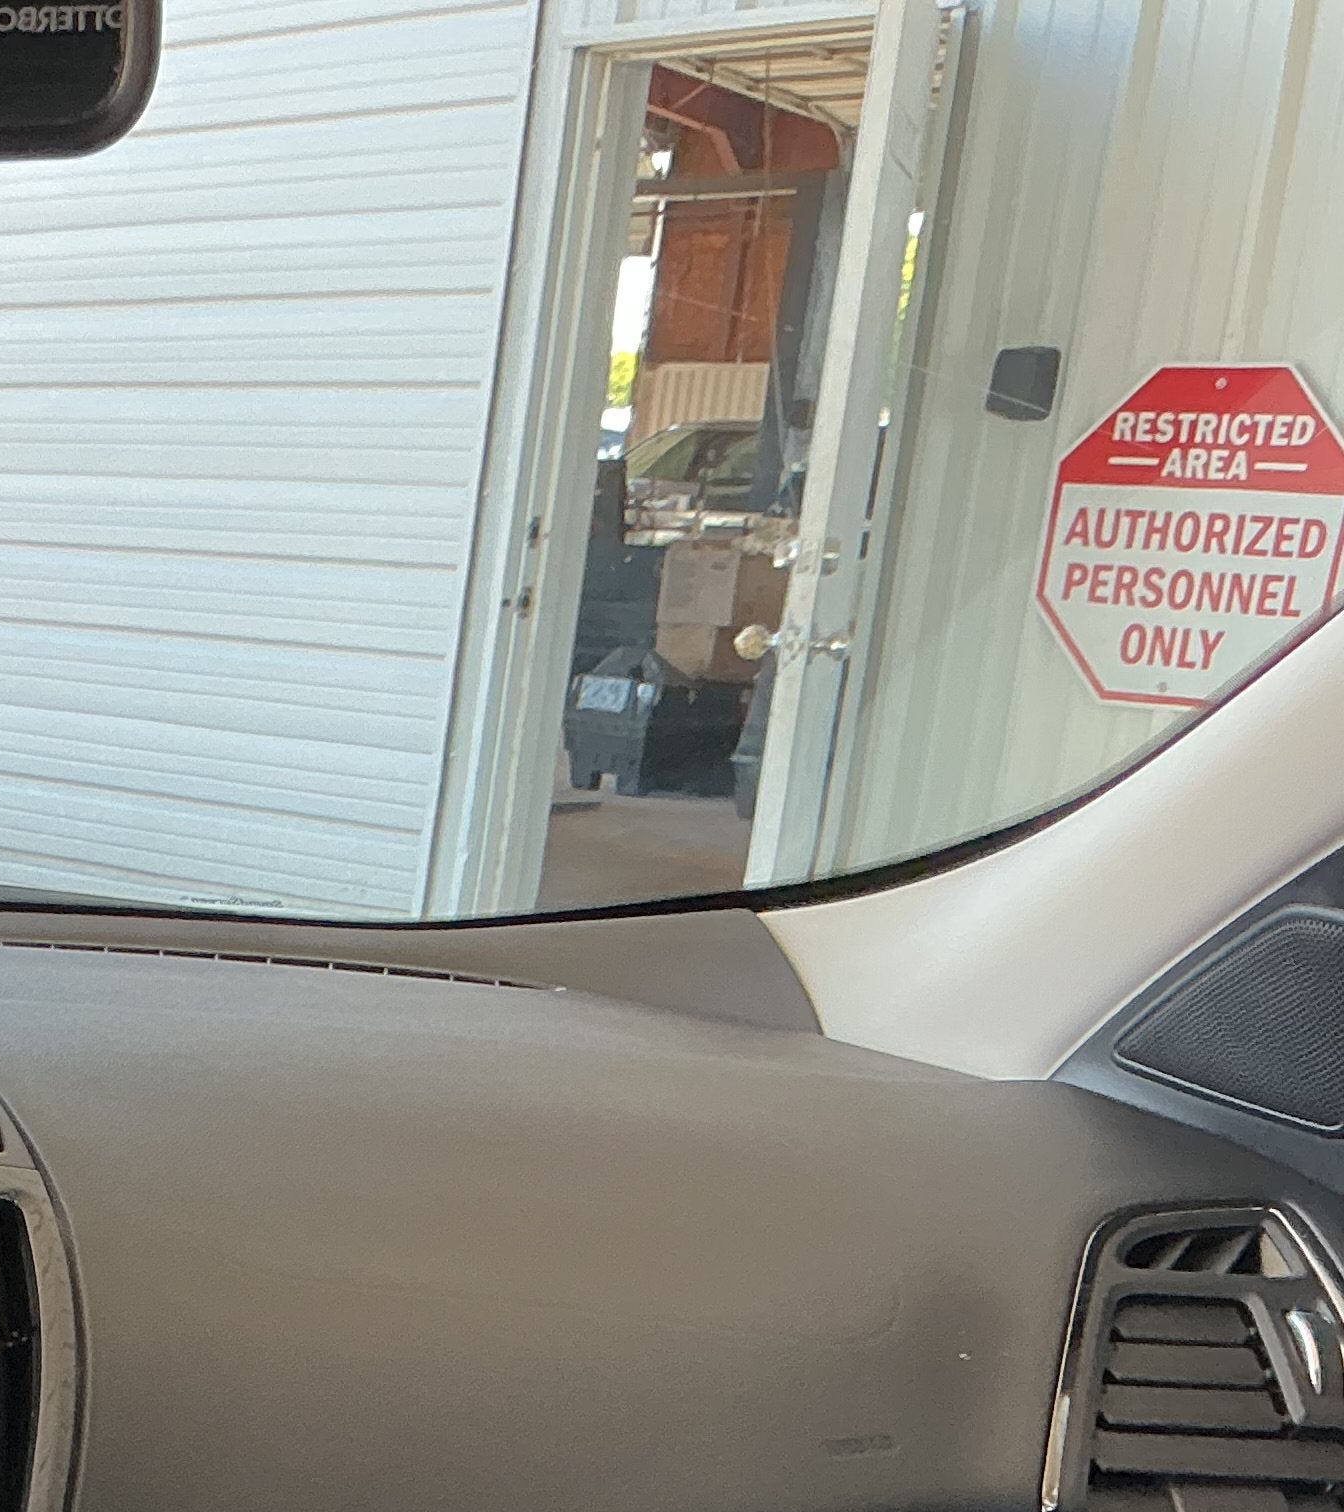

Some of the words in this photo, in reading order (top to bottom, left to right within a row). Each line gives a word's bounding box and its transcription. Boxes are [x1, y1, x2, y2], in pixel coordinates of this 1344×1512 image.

[1112, 411, 1316, 447] RESTRICTED
[1160, 448, 1249, 481] AREA
[1063, 506, 1328, 560] AUTHORIZED
[1061, 562, 1302, 619] PERSONNEL
[1119, 623, 1226, 671] ONLY
